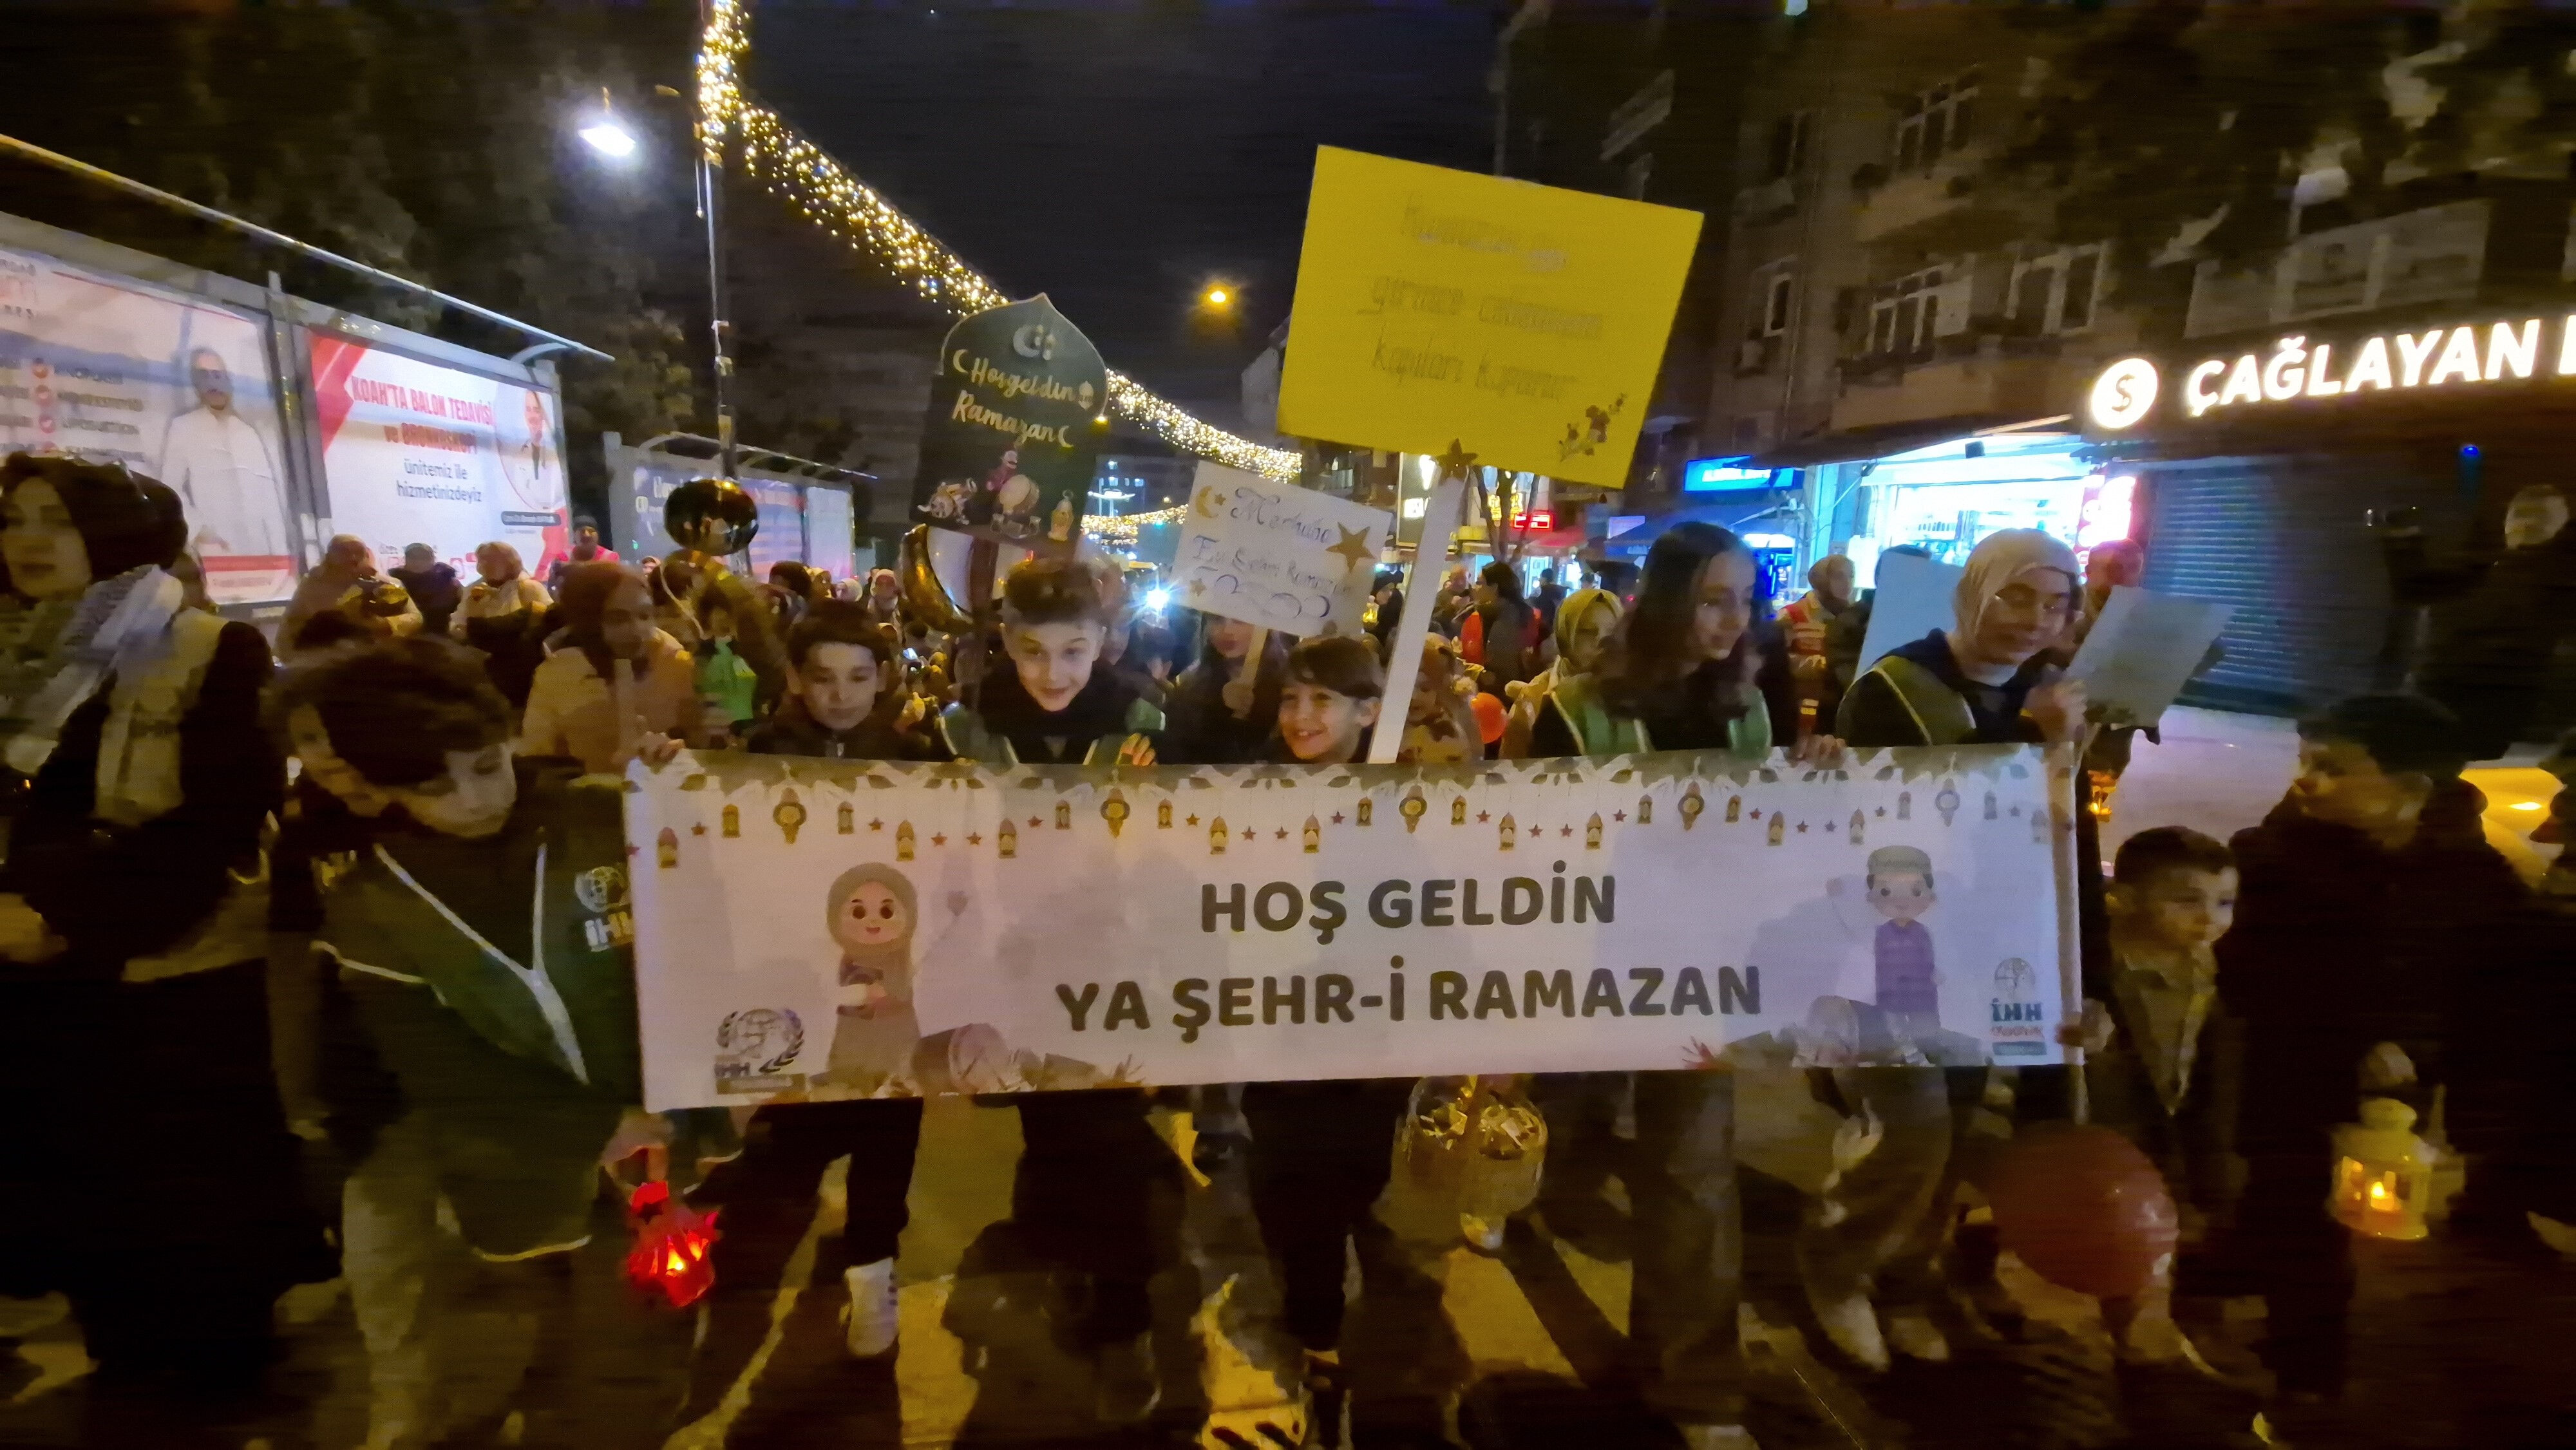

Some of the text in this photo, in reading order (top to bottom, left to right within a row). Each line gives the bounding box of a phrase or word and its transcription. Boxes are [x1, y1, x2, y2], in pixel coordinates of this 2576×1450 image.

[2186, 319, 2540, 417] ÇAĞLAYAN
[410, 388, 447, 417] BALON
[952, 390, 1055, 449] Ramazan
[397, 480, 482, 504] hizmetinizdeyiz
[404, 458, 452, 479] ünitemiz
[1201, 860, 1615, 945] HOŞ GELDİN
[1054, 955, 1761, 1044] YA ŞEHR-İ RAMAZAN
